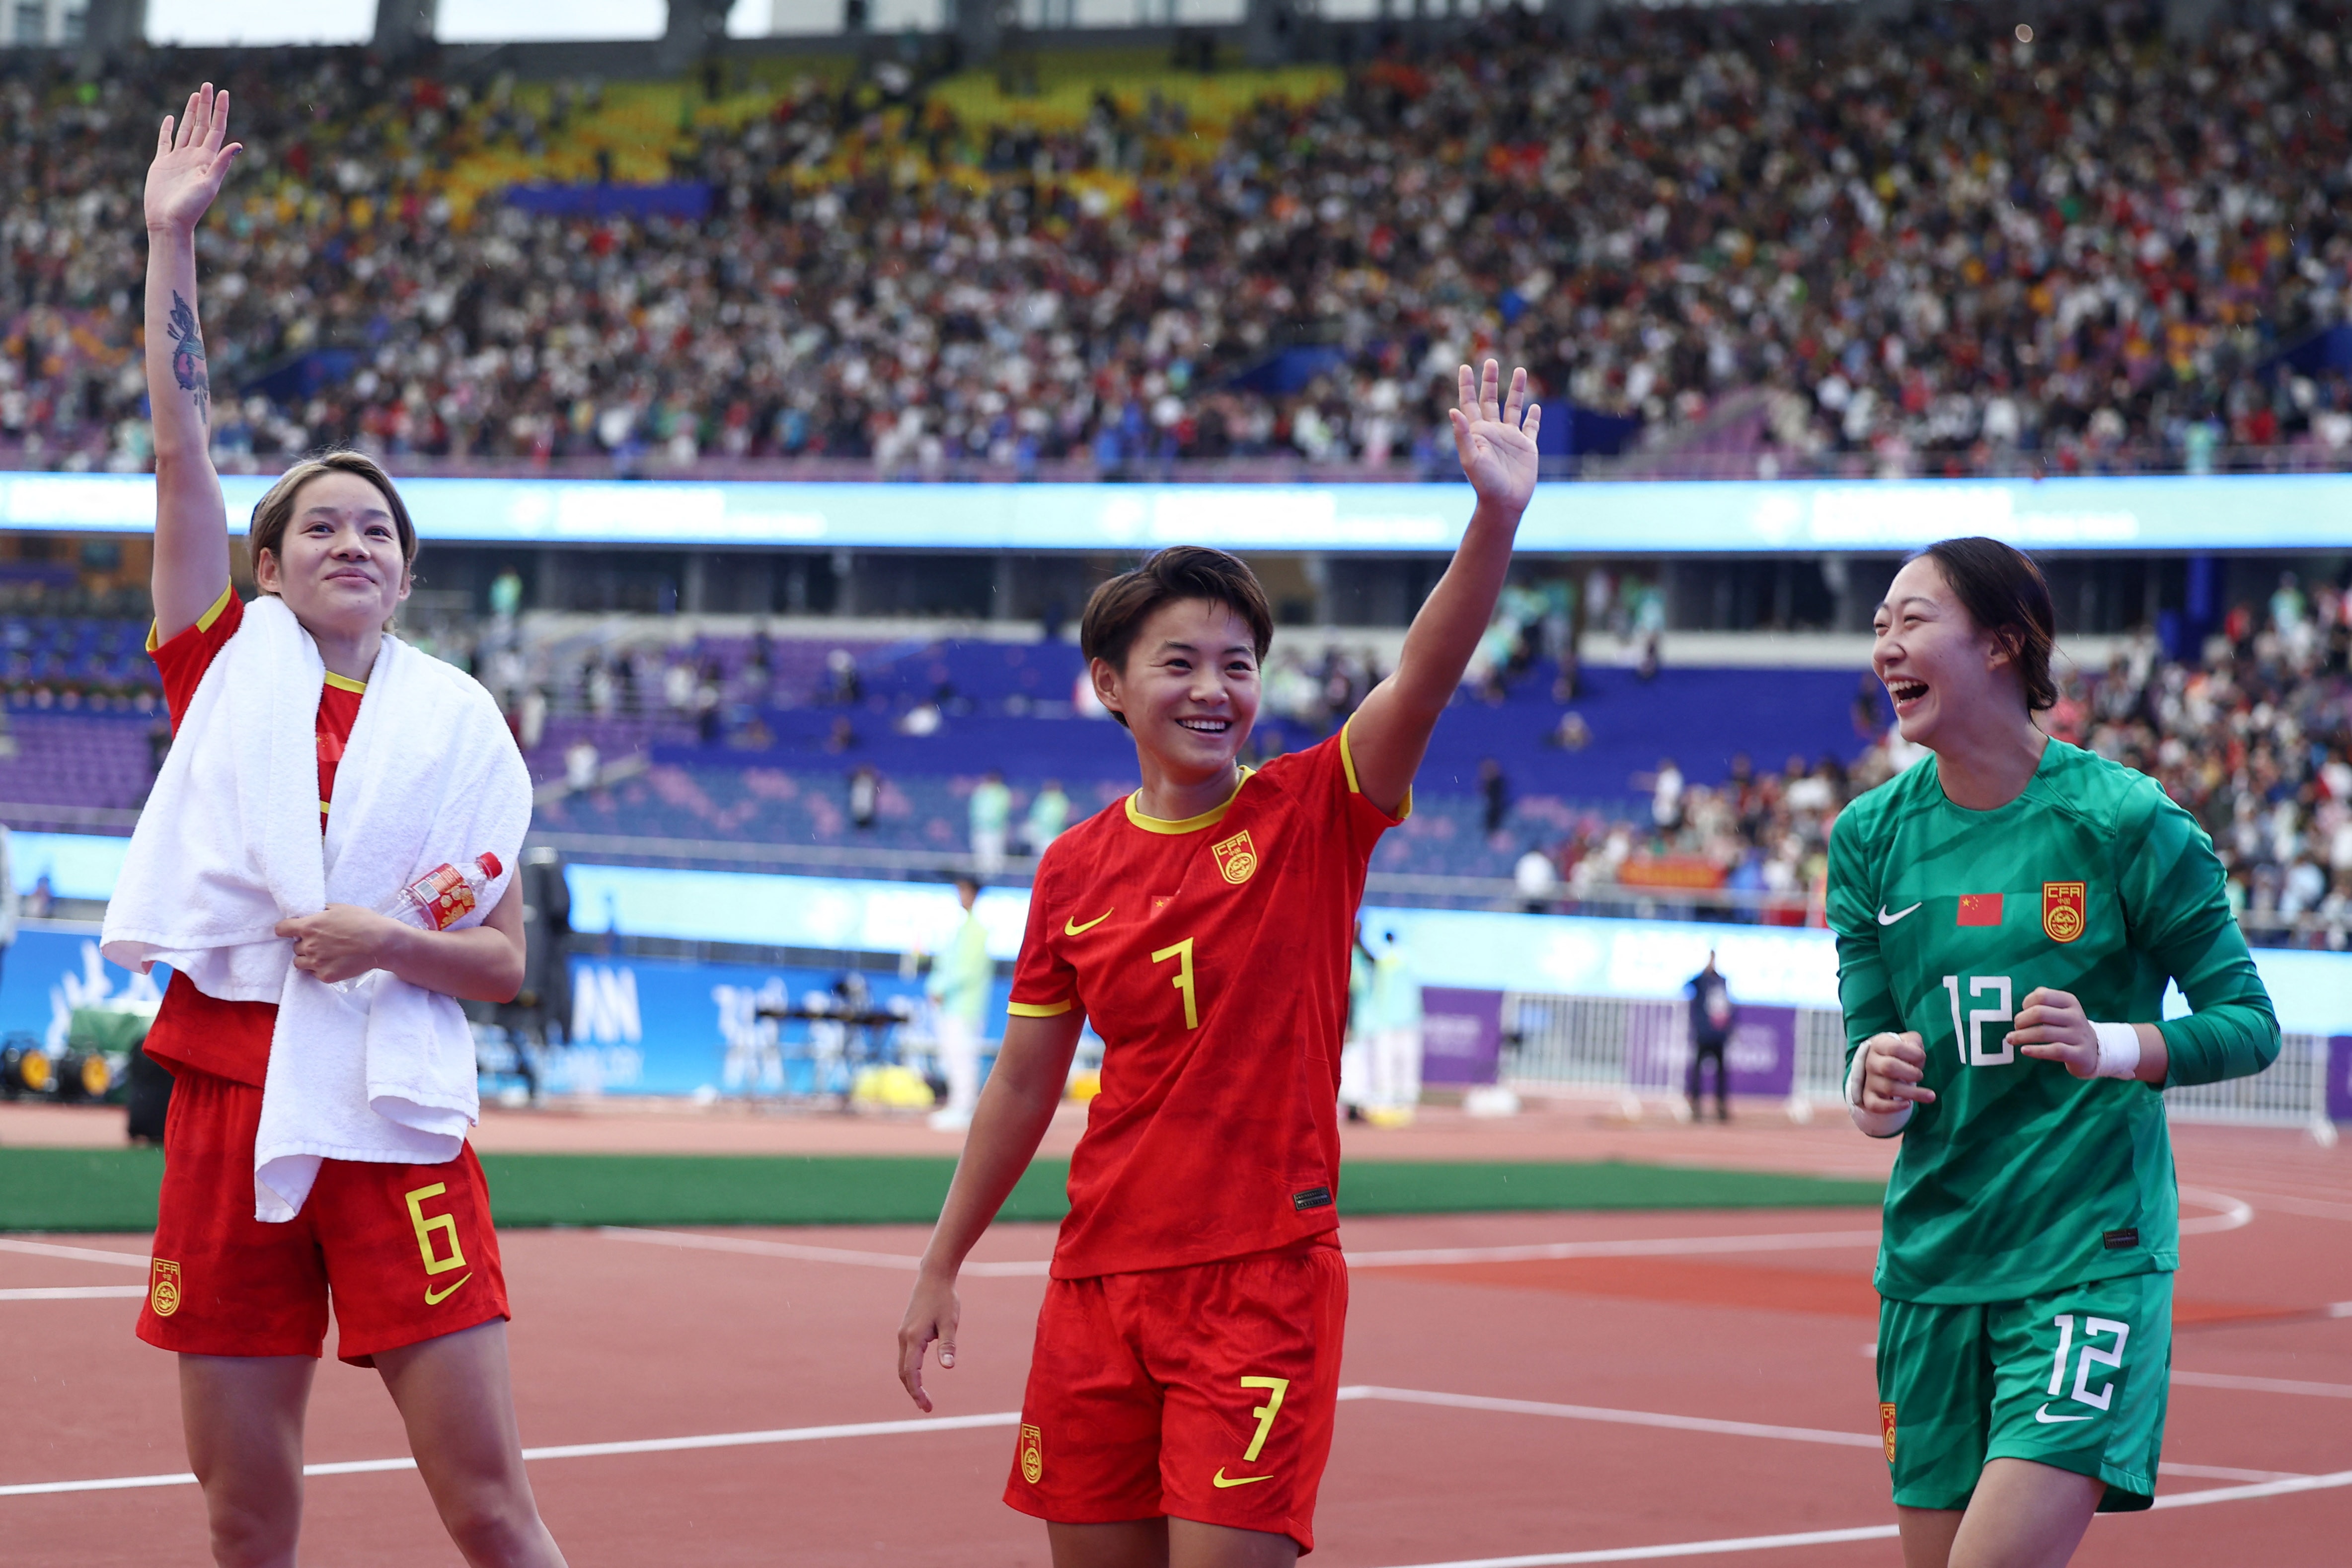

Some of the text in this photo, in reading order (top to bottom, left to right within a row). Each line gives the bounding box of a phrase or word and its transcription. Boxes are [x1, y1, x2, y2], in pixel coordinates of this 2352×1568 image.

[1216, 834, 1247, 856] CFA
[2048, 887, 2080, 898] CFA
[1151, 937, 1198, 1030] 7
[1943, 975, 2015, 1066] 12
[156, 1262, 178, 1275] CFA
[405, 1182, 466, 1275] 6
[2048, 1314, 2129, 1411] 12
[1024, 1427, 1040, 1440] CFA
[1240, 1376, 1290, 1462] 7
